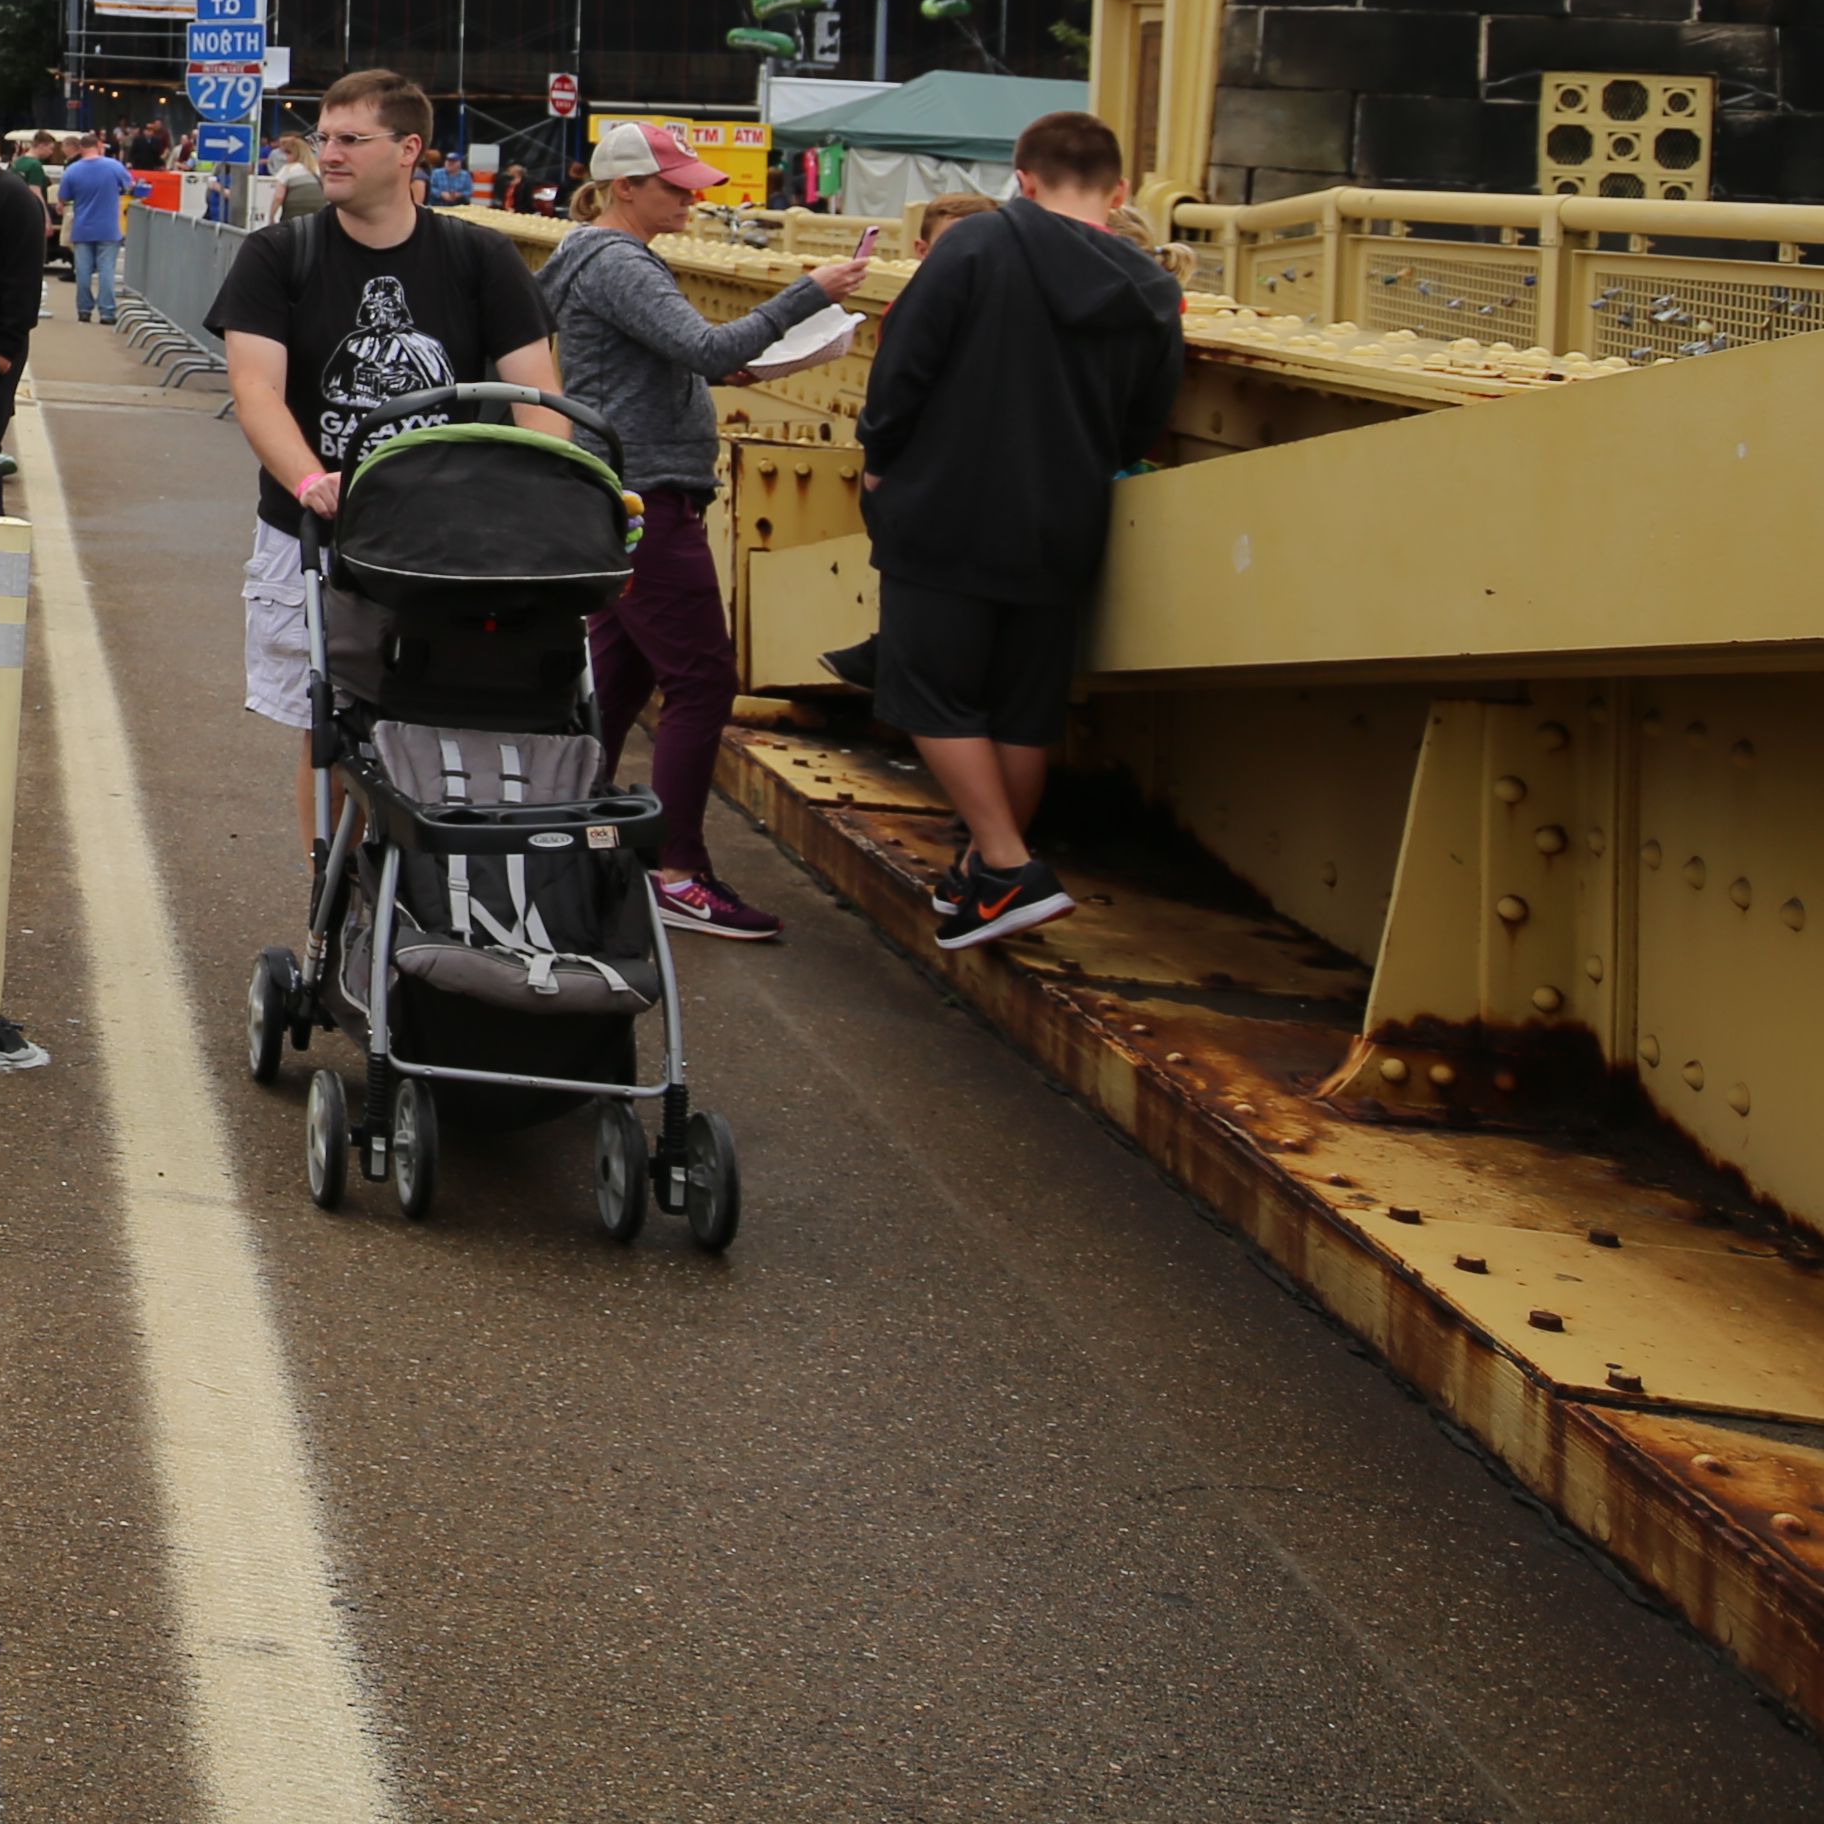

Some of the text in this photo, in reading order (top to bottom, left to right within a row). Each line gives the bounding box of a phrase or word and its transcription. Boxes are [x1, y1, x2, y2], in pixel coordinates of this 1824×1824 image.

[192, 31, 260, 53] NORTH
[197, 76, 258, 110] 279
[692, 129, 719, 143] TM
[734, 128, 764, 143] ATM
